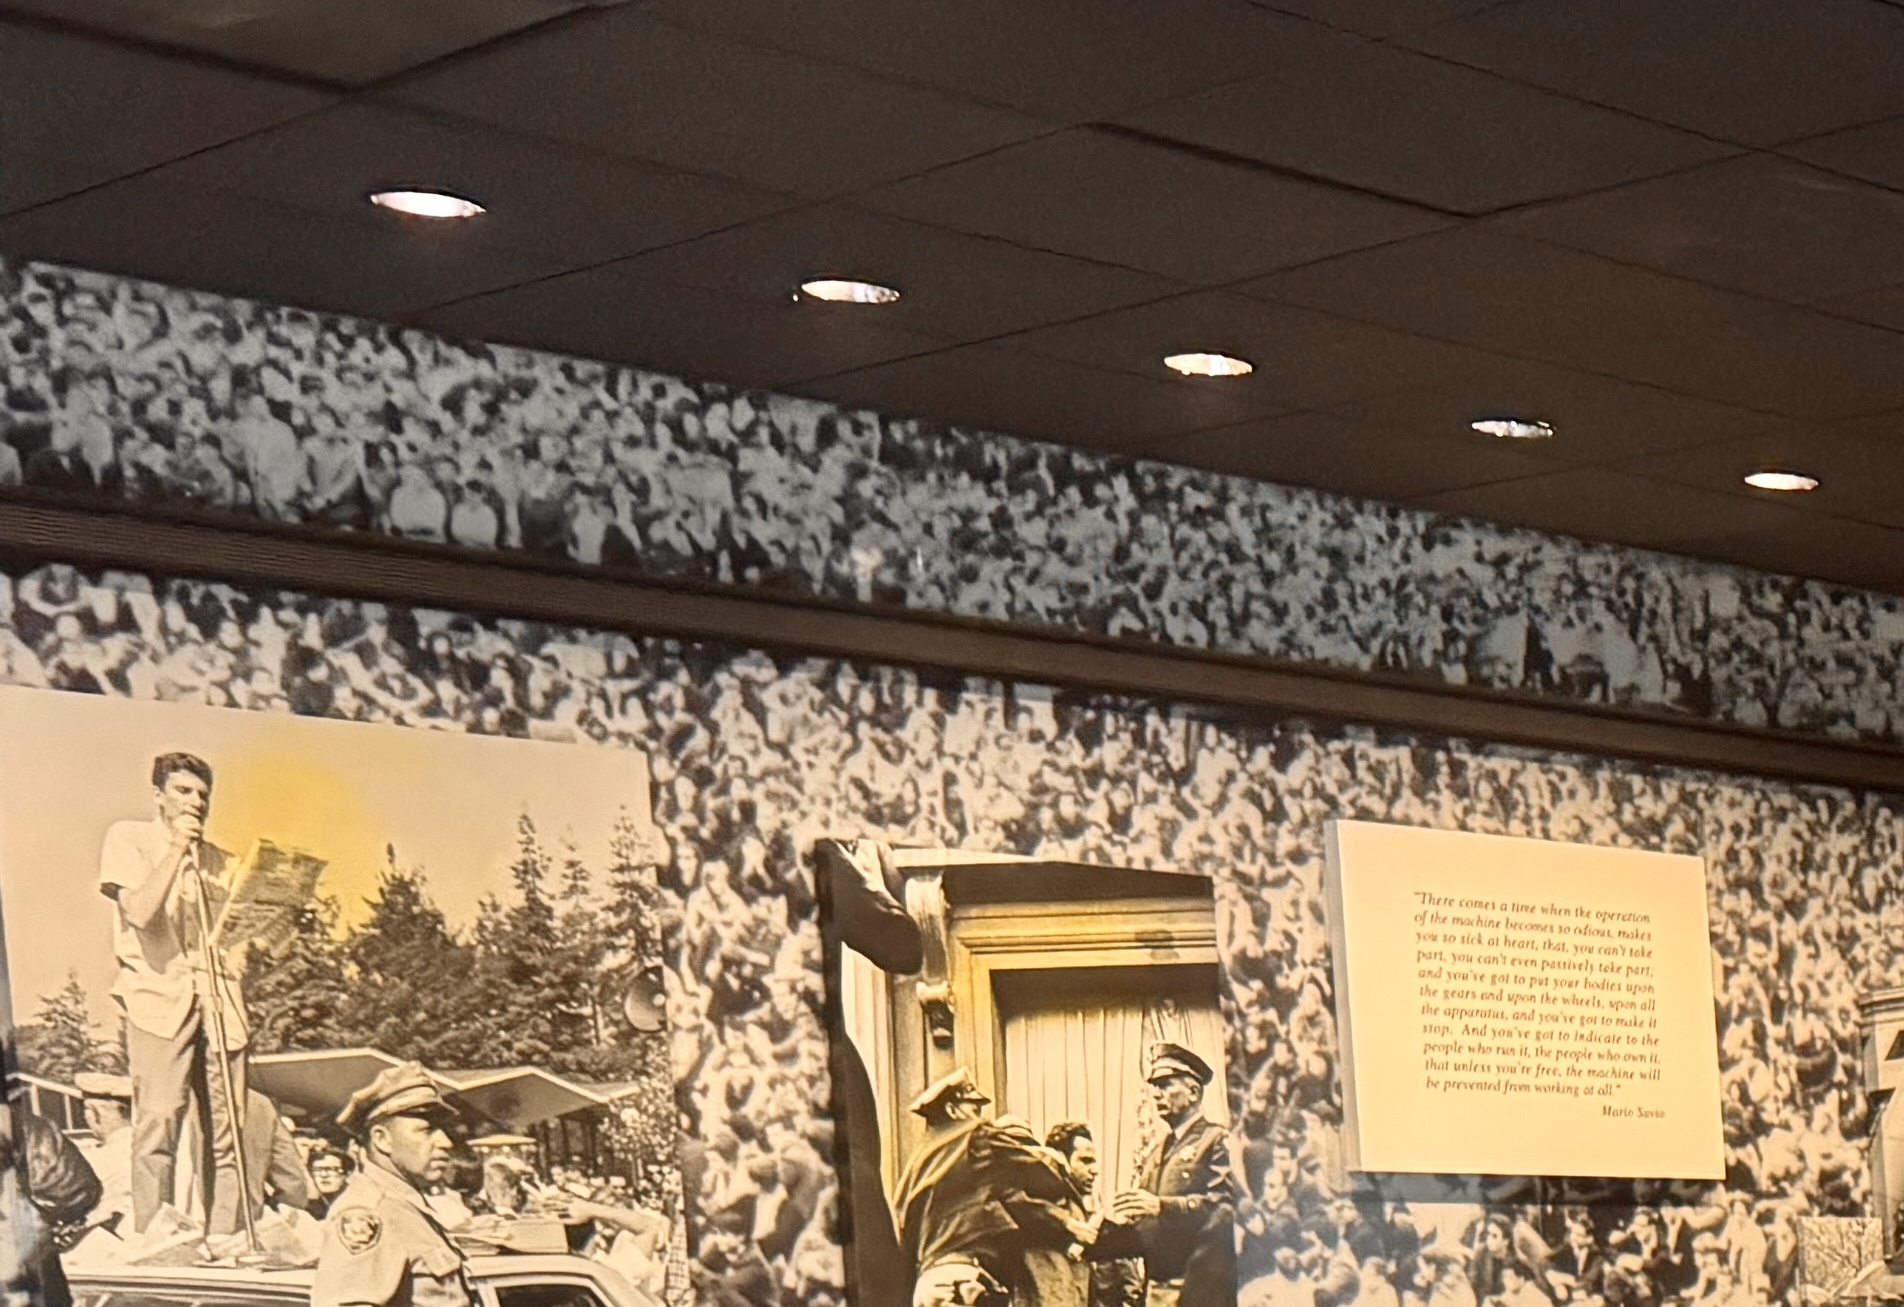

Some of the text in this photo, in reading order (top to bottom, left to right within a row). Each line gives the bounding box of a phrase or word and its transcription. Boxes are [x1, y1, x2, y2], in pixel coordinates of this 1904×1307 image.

[1459, 899, 1495, 910] comes
[1501, 902, 1507, 911] a
[1512, 902, 1536, 914] time
[1541, 903, 1570, 917] when
[1575, 905, 1591, 918] the
[1414, 911, 1428, 928] of
[1431, 912, 1448, 925] the
[1452, 915, 1501, 929] machine
[1559, 925, 1570, 935] so
[1618, 928, 1651, 941] makes
[1416, 932, 1438, 946] you
[1443, 934, 1456, 944] so
[1461, 933, 1483, 946] sick
[1488, 936, 1499, 947] at
[1574, 944, 1594, 958] you
[1630, 945, 1652, 958] take
[1452, 953, 1473, 967] you
[1511, 957, 1537, 968] even
[1600, 961, 1622, 974] take
[1419, 967, 1442, 980] and
[1491, 973, 1509, 988] got
[1514, 974, 1525, 985] to
[1530, 976, 1548, 990] put
[1554, 978, 1579, 992] your
[1584, 977, 1621, 992] bodies
[1626, 983, 1654, 997] upon
[1420, 985, 1438, 998] the
[1443, 989, 1476, 1003] gears
[1481, 989, 1503, 1002] and
[1508, 993, 1536, 1008] upon
[1541, 992, 1558, 1005] the
[1609, 1000, 1636, 1014] upon
[1640, 998, 1655, 1011] all
[1422, 1003, 1440, 1016] the
[1512, 1009, 1535, 1022] and
[1580, 1015, 1597, 1029] got
[1601, 1015, 1612, 1026] to
[1616, 1015, 1644, 1028] make
[1649, 1017, 1656, 1029] it
[1462, 1023, 1487, 1037] And
[1536, 1030, 1554, 1045] got
[1559, 1031, 1569, 1042] to
[1575, 1030, 1621, 1045] indicate
[1626, 1034, 1637, 1045] to
[1642, 1034, 1660, 1047] the
[1423, 1041, 1463, 1058] people
[1468, 1043, 1492, 1056] who
[1496, 1047, 1515, 1057] run
[1536, 1046, 1552, 1059] the
[1556, 1048, 1593, 1065] people
[1597, 1049, 1620, 1062] who
[1624, 1053, 1646, 1064] own
[1426, 1058, 1449, 1072] that
[1454, 1060, 1490, 1073] unless
[1567, 1064, 1583, 1077] the
[1588, 1066, 1634, 1079] machine
[1640, 1068, 1660, 1081] will
[1426, 1076, 1440, 1089] be
[1444, 1079, 1500, 1094] prevented
[1503, 1079, 1530, 1096] from
[1534, 1081, 1579, 1099] working
[1583, 1084, 1593, 1095] at
[1602, 1105, 1634, 1117] Mario
